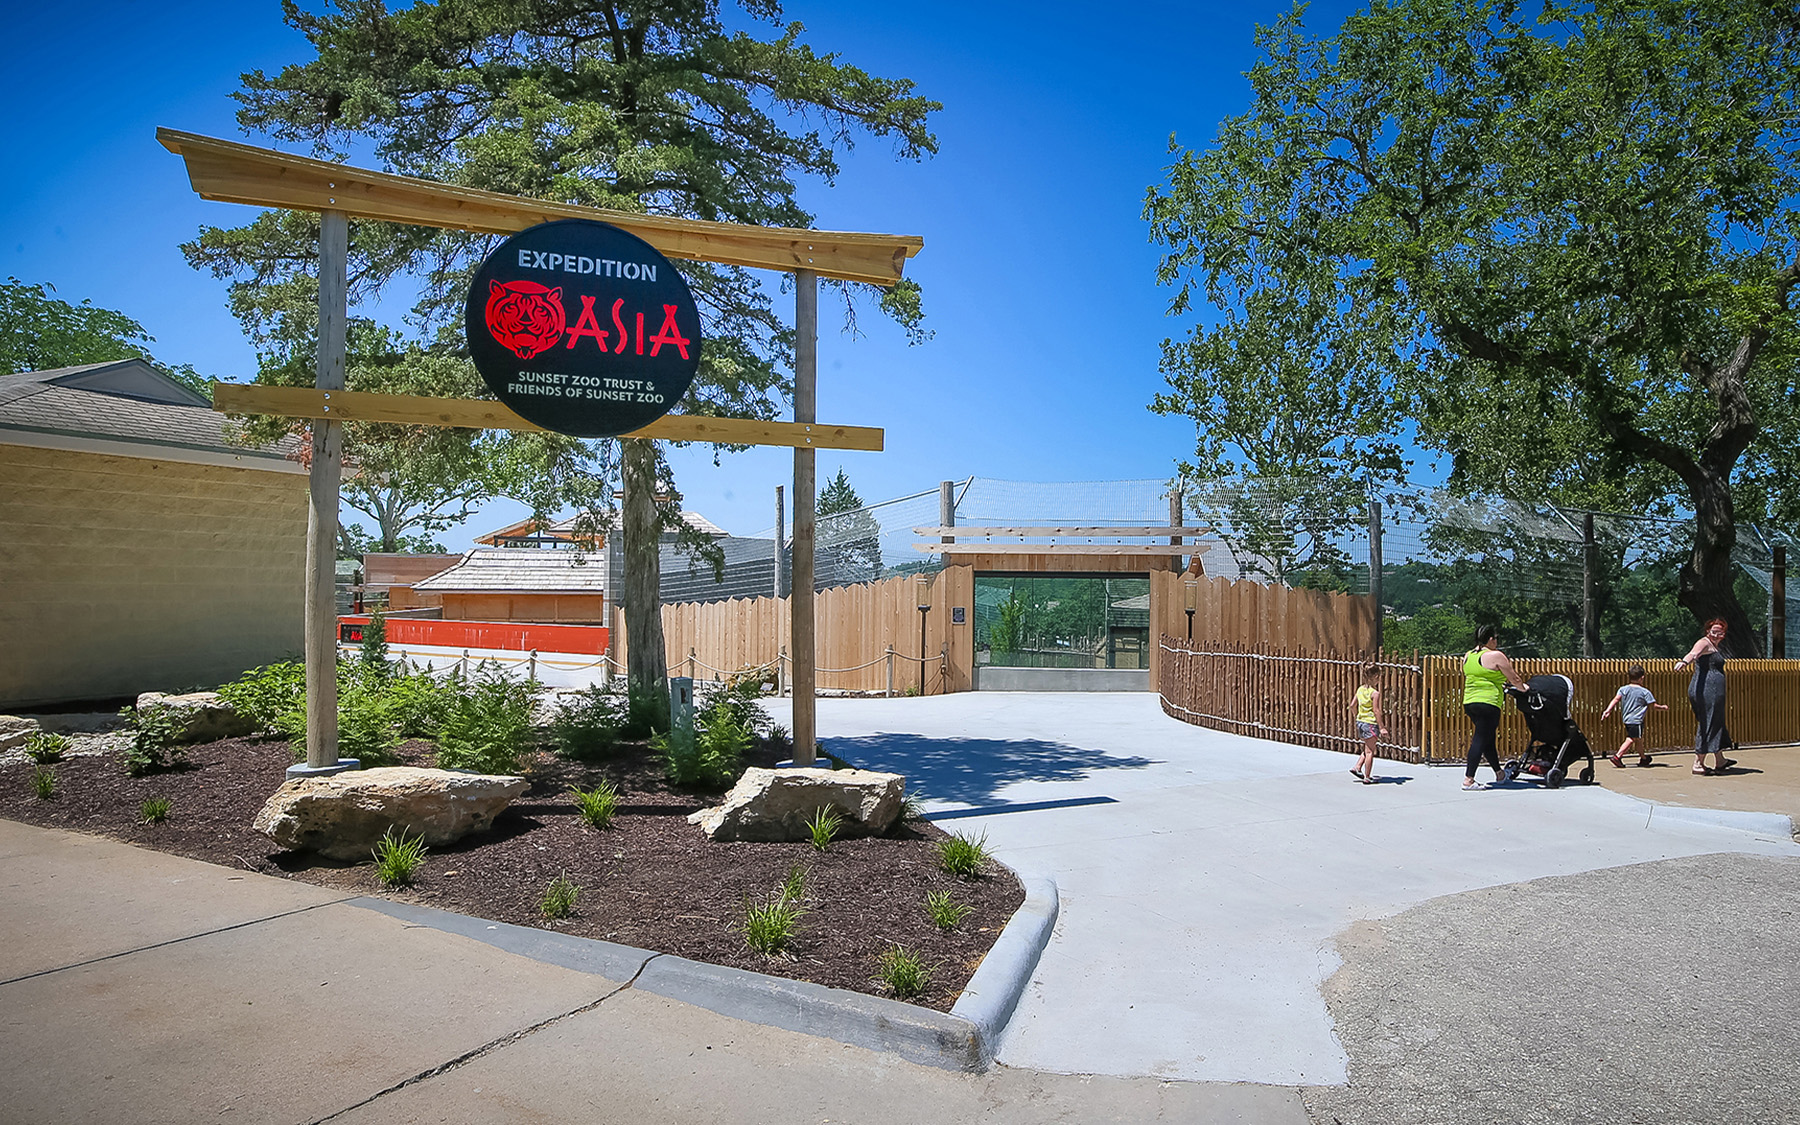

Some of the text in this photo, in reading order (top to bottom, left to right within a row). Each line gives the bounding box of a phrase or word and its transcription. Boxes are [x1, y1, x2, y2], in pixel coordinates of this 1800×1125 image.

[518, 249, 657, 282] EXPEDITION
[566, 295, 690, 360] ASIA
[508, 383, 664, 404] FRIENDS OF SUNSET ZOO
[518, 371, 655, 392] SUNSET ZOO TRUST &
